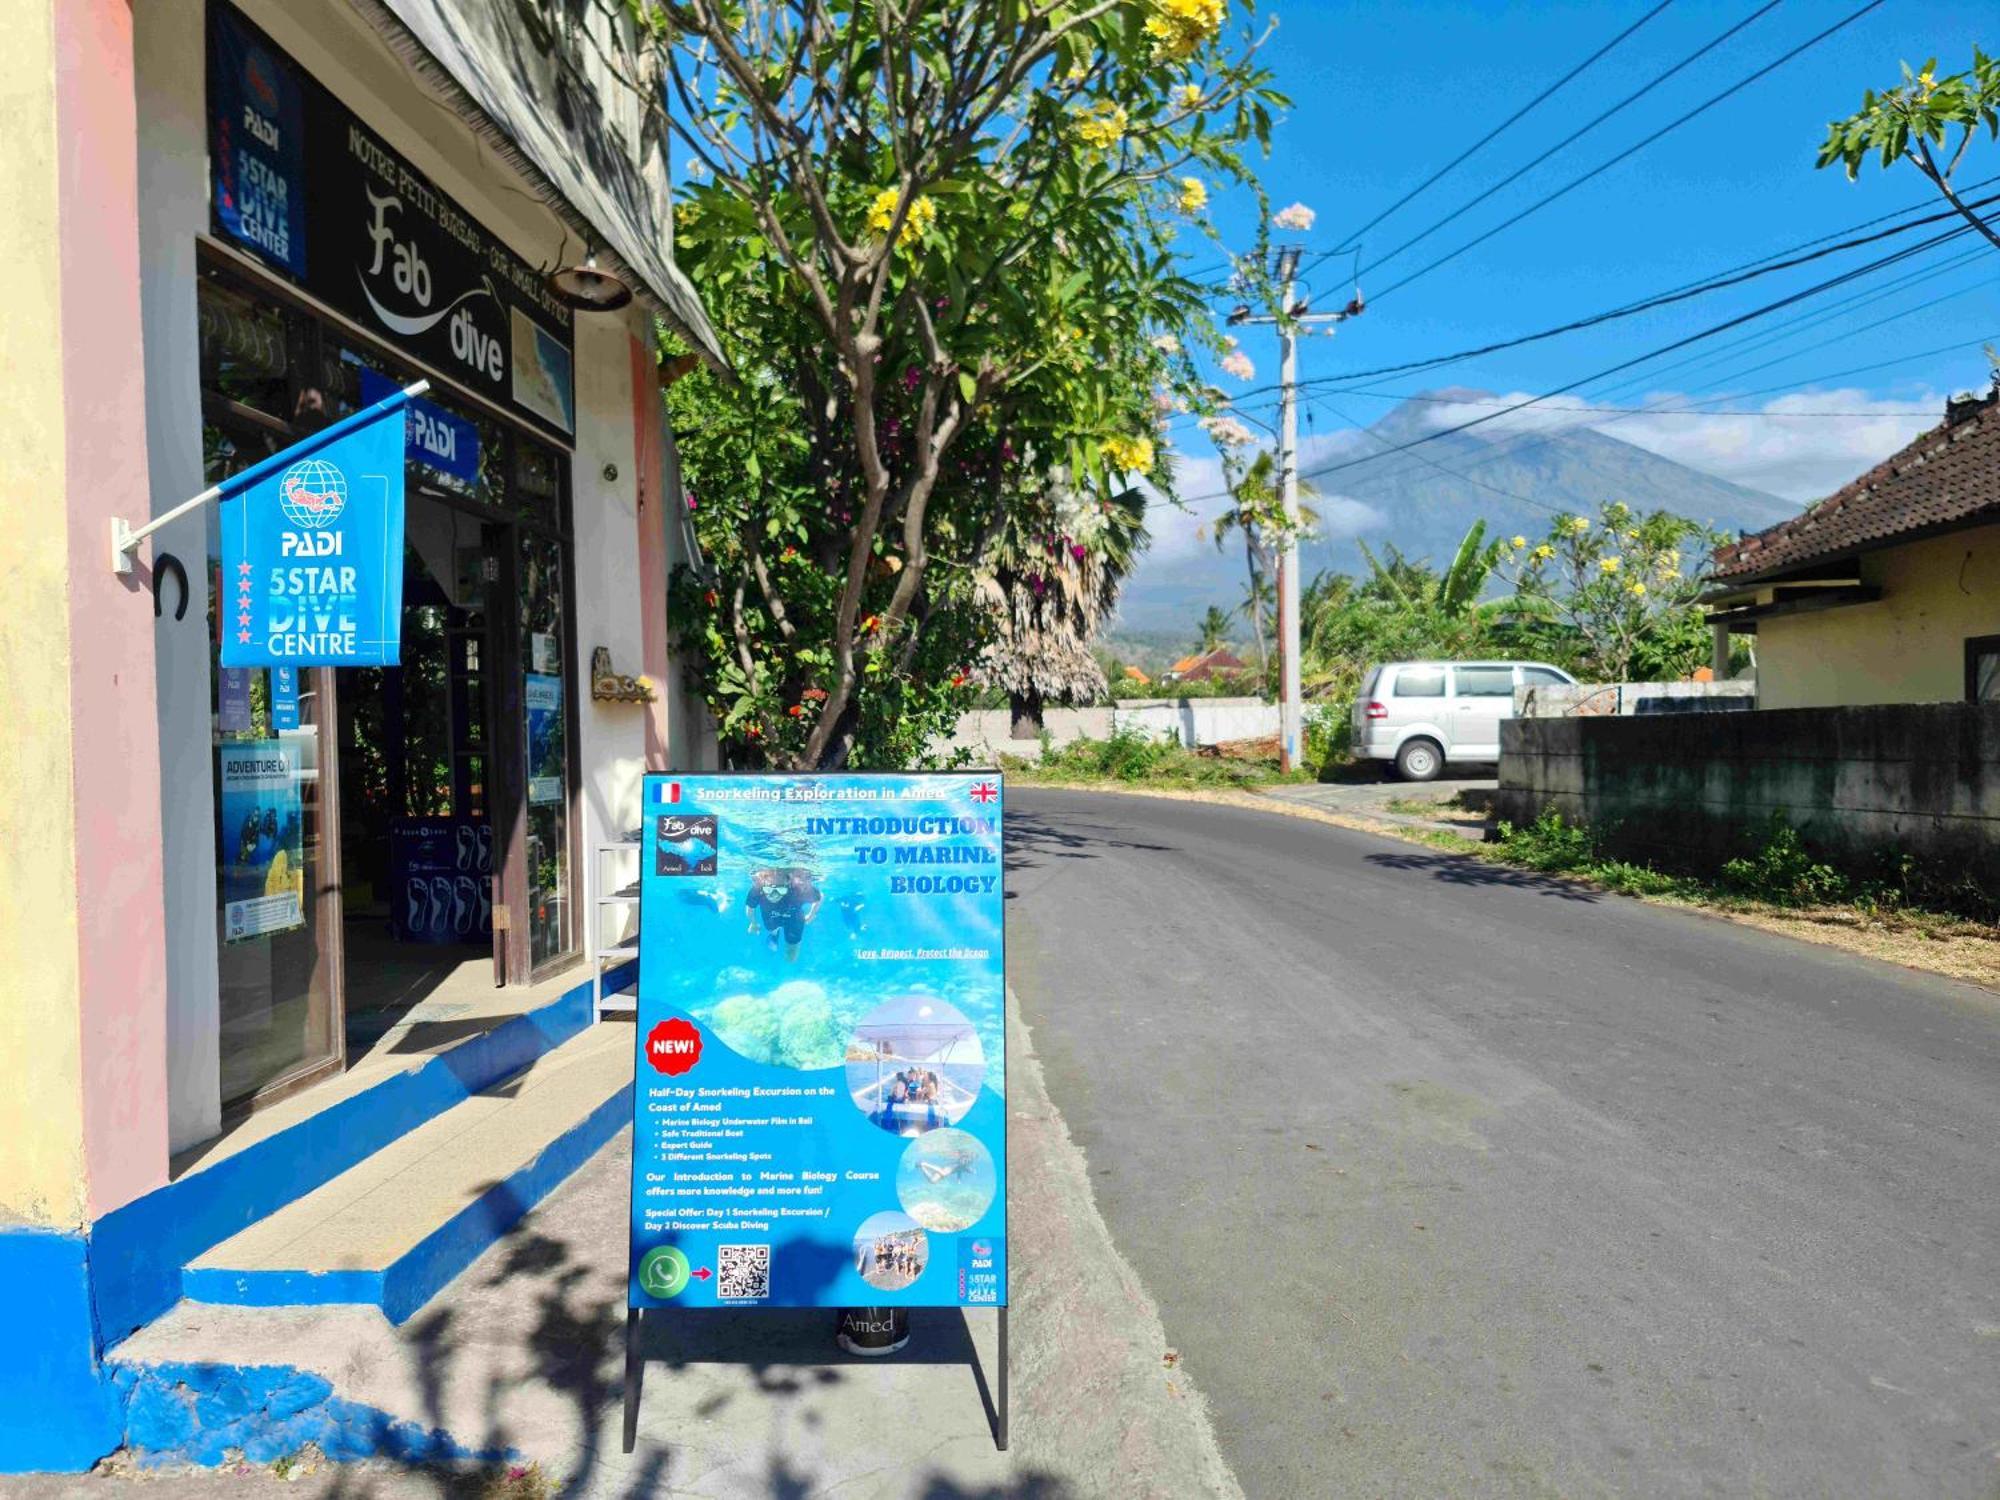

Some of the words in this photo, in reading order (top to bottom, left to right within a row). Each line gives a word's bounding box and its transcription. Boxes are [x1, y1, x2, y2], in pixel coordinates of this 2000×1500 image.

[244, 105, 279, 151] PADI
[349, 124, 396, 187] NOTRE
[240, 173, 289, 240] DIVE
[241, 213, 289, 261] CENTER
[366, 181, 432, 308] Fab
[451, 307, 504, 382] dive
[414, 408, 456, 462] PADI
[282, 531, 343, 557] PADI
[268, 595, 357, 633] DIVE
[268, 633, 357, 656] CENTRE
[227, 760, 277, 773] ADVENTURE
[696, 786, 781, 801] Snorkeling
[785, 786, 877, 801] Exploration
[881, 787, 895, 800] in
[663, 816, 685, 832] Fab
[690, 825, 713, 835] dive
[806, 817, 996, 834] INTRODUCTION
[854, 846, 888, 864] TO
[894, 846, 996, 864] MARINE
[890, 876, 996, 893] BIOLOGY
[653, 1040, 694, 1054] NEW!
[649, 1087, 695, 1098] Half-Day
[698, 1087, 751, 1098] Snorkeling
[753, 1087, 802, 1096] Excursion
[803, 1088, 816, 1096] on
[818, 1087, 835, 1095] the
[648, 1103, 677, 1111] Coast
[679, 1102, 691, 1111] of
[692, 1102, 722, 1111] Amed
[661, 1118, 690, 1126] Marine
[691, 1117, 720, 1128] Biology
[722, 1117, 769, 1126] Underwater
[770, 1117, 788, 1125] Film
[661, 1130, 680, 1138] Safe
[681, 1130, 723, 1138] Traditional
[661, 1142, 688, 1151] Expert
[689, 1142, 713, 1150] Guide
[668, 1153, 704, 1161] Different
[705, 1152, 748, 1162] Snorkeling
[646, 1172, 666, 1182] Our
[674, 1172, 734, 1181] Introduction
[741, 1172, 752, 1181] to
[760, 1172, 794, 1180] Marine
[802, 1171, 838, 1182] Biology
[846, 1171, 880, 1180] Course
[646, 1186, 675, 1196] offers
[677, 1188, 701, 1196] more
[703, 1186, 755, 1197] knowledge
[757, 1186, 775, 1195] and
[777, 1187, 801, 1195] more
[803, 1185, 823, 1195] fun!
[645, 1208, 676, 1219] Special
[678, 1207, 704, 1217] Offer:
[706, 1208, 724, 1218] Day
[732, 1207, 779, 1218] Snorkeling
[780, 1207, 823, 1217] Excursion
[644, 1221, 662, 1232] Day
[672, 1221, 710, 1230] Discover
[712, 1221, 739, 1230] Scuba
[740, 1221, 769, 1231] Diving
[843, 1309, 894, 1333] Amed
